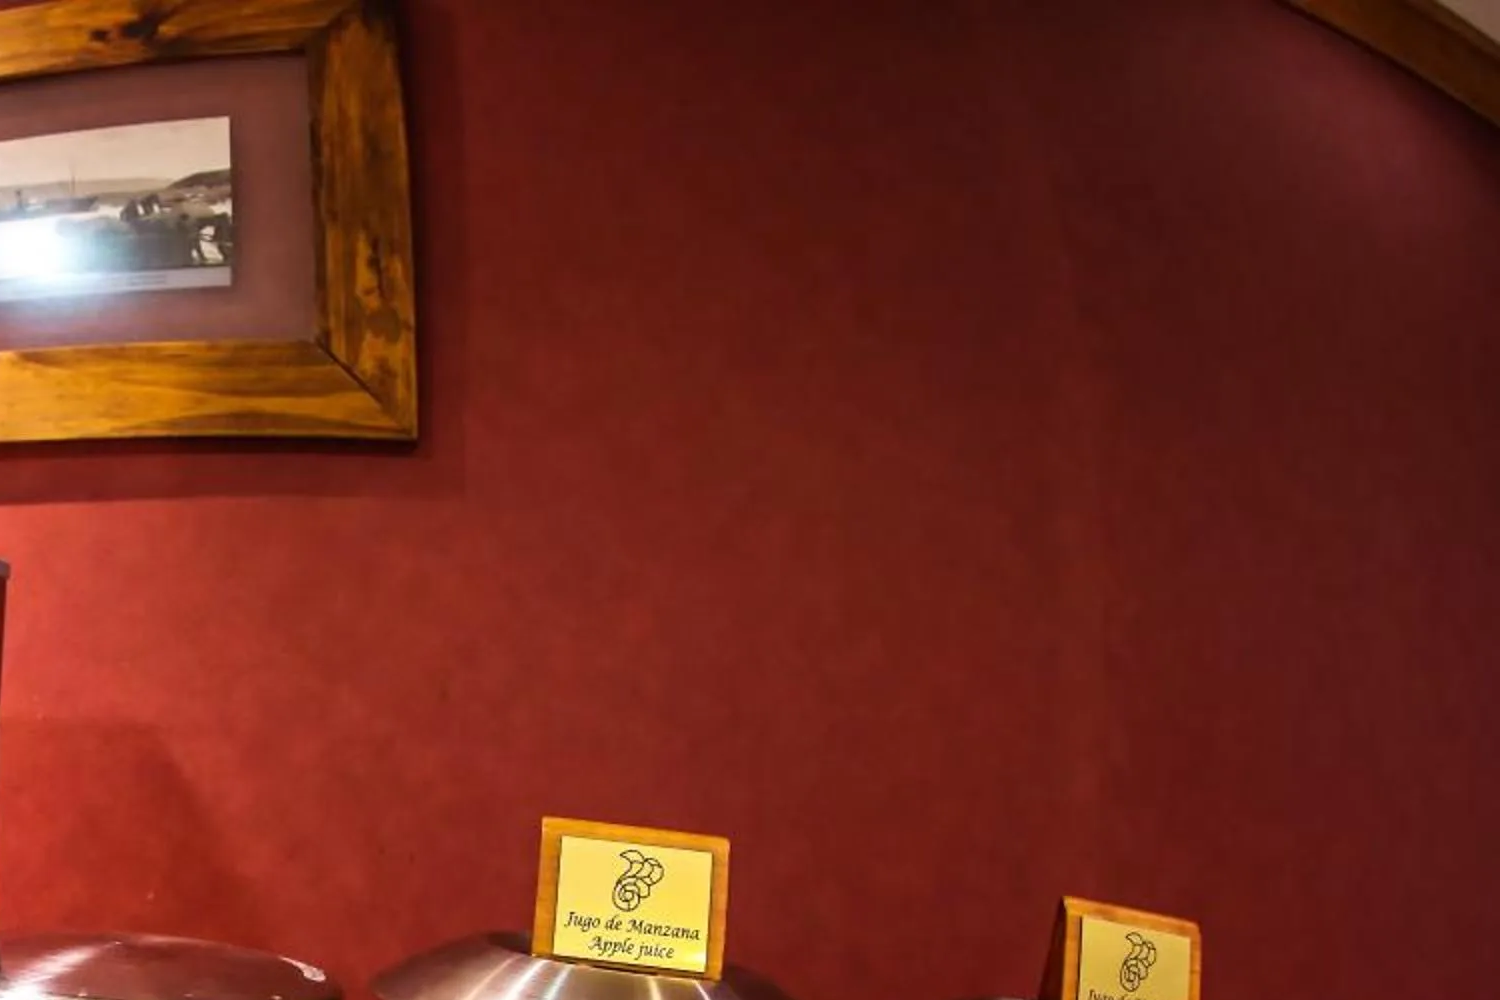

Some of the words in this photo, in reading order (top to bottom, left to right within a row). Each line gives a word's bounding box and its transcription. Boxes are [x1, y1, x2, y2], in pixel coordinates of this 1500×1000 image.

[564, 911, 601, 932] Jugo
[604, 914, 623, 931] de
[626, 918, 701, 941] Manzana
[588, 935, 635, 957] Apple
[634, 941, 675, 960] juice
